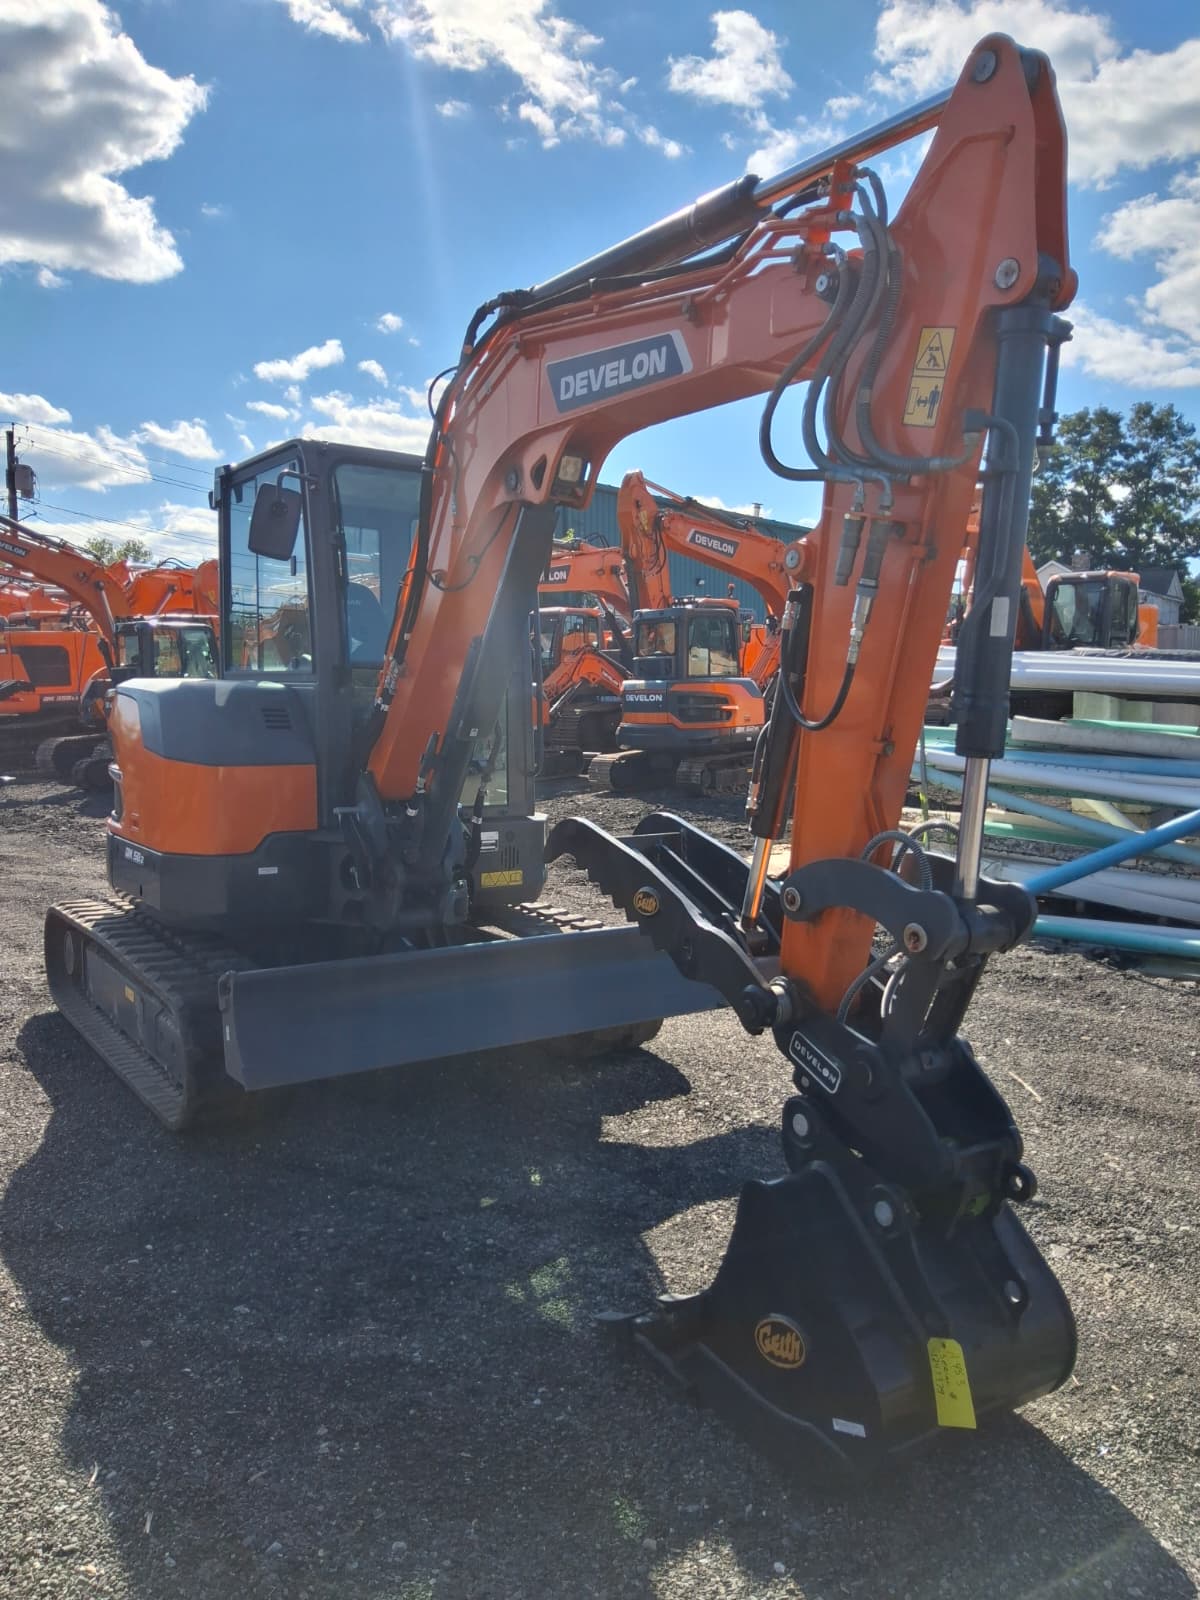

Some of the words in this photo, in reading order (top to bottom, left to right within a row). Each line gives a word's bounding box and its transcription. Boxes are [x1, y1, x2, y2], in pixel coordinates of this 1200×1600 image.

[559, 345, 667, 401] DEVELON
[694, 533, 734, 555] DEVELON
[625, 694, 663, 702] DEVELON
[794, 1040, 837, 1084] DEVELON
[758, 1324, 801, 1361] Geith
